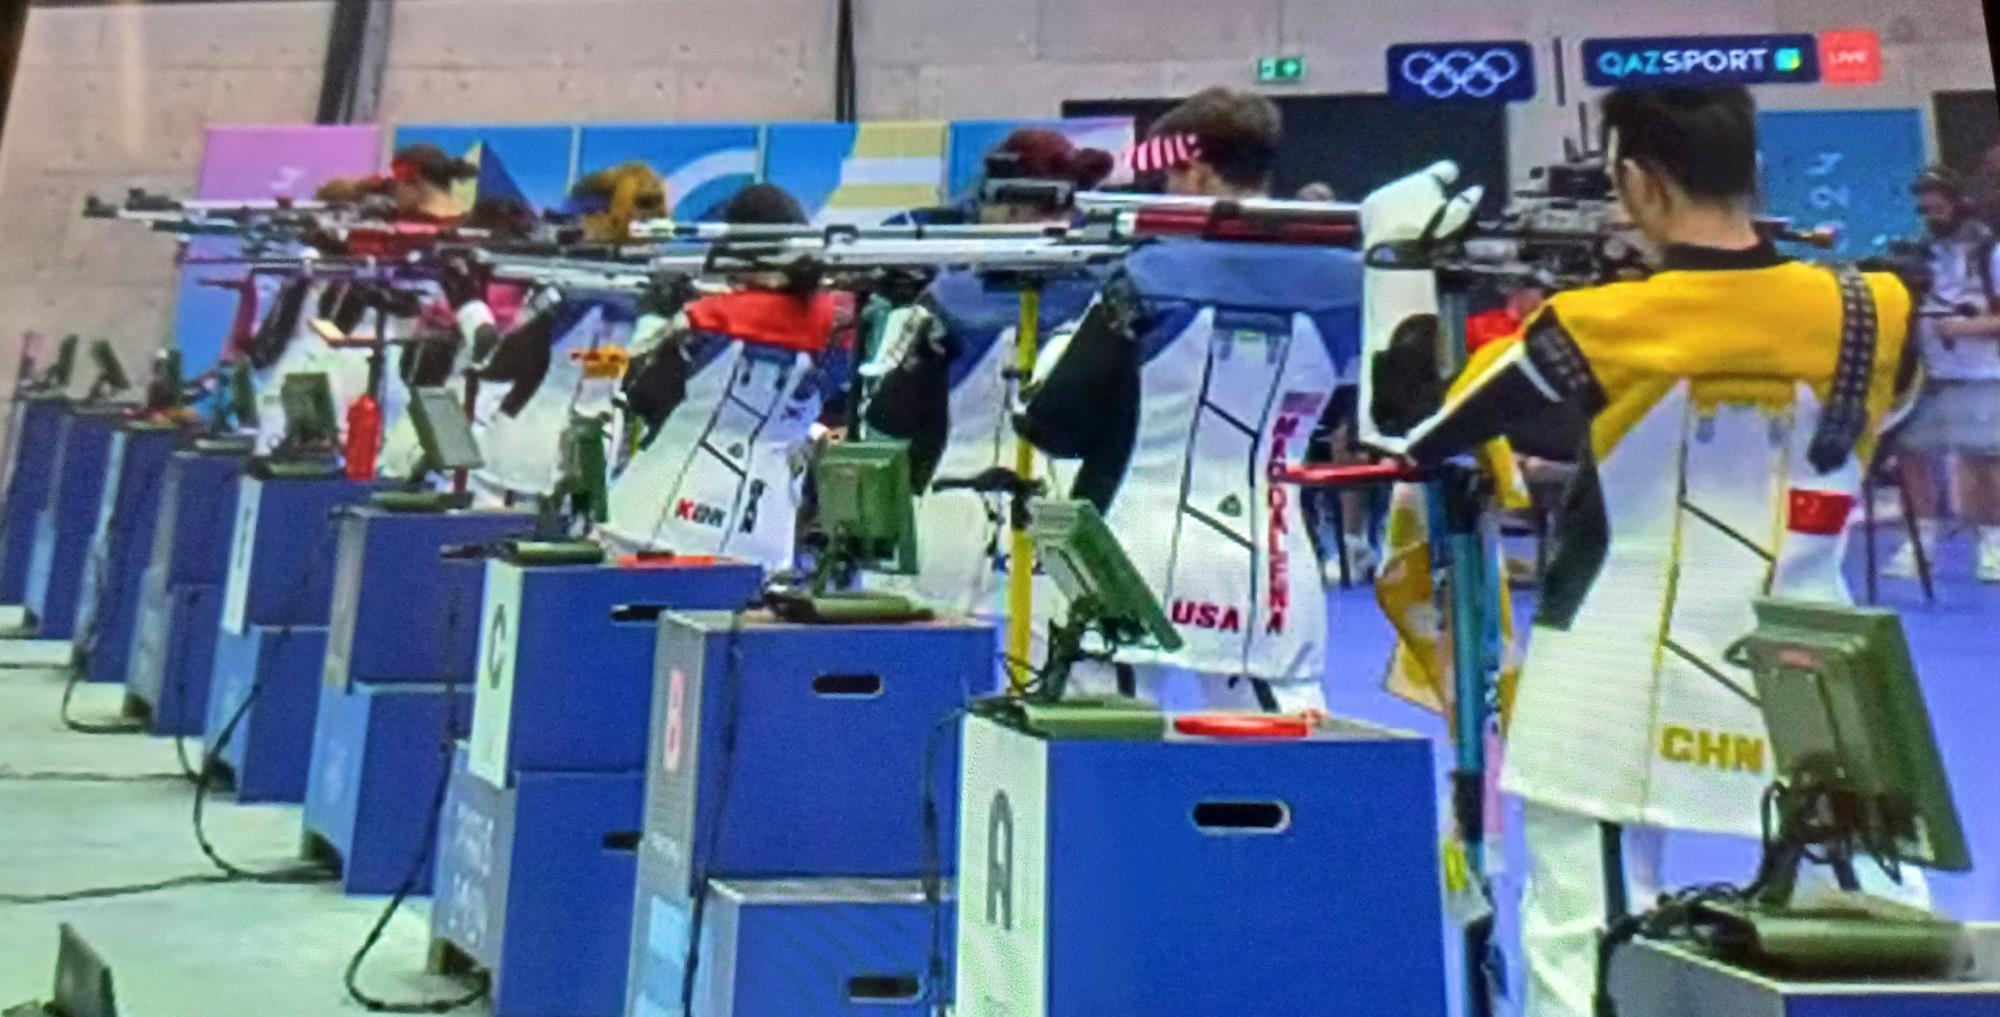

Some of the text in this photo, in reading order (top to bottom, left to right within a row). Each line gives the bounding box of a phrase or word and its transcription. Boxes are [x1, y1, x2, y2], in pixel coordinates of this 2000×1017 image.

[1596, 48, 1769, 77] QAZSPORT
[1172, 599, 1240, 634] USA
[488, 602, 507, 690] C
[1660, 724, 1764, 773] CHN
[985, 788, 1014, 932] A
